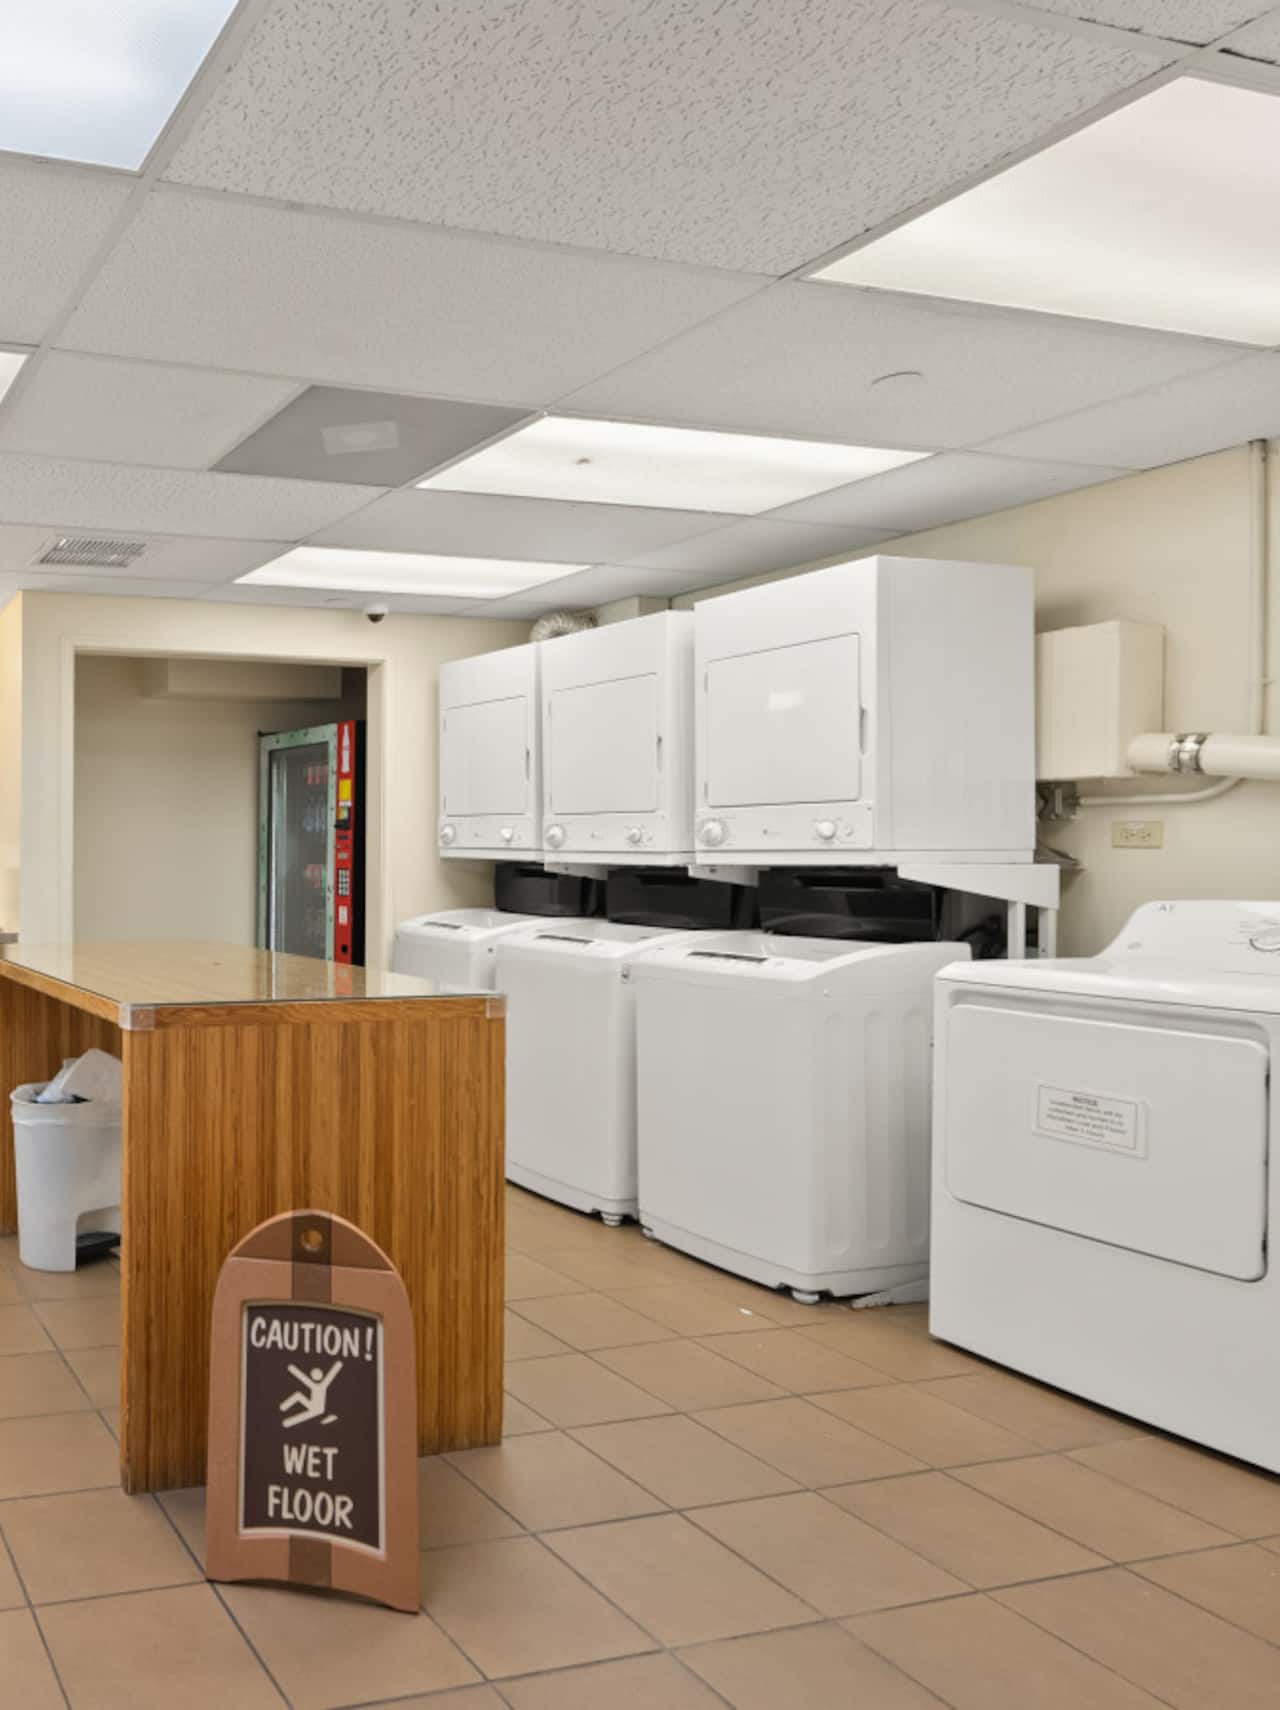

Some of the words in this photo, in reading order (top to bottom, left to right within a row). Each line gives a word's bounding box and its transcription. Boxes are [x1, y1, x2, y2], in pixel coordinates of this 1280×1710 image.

[250, 1316, 373, 1361] CAUTION!
[283, 1443, 339, 1481] WET
[268, 1485, 354, 1529] FLOOR
